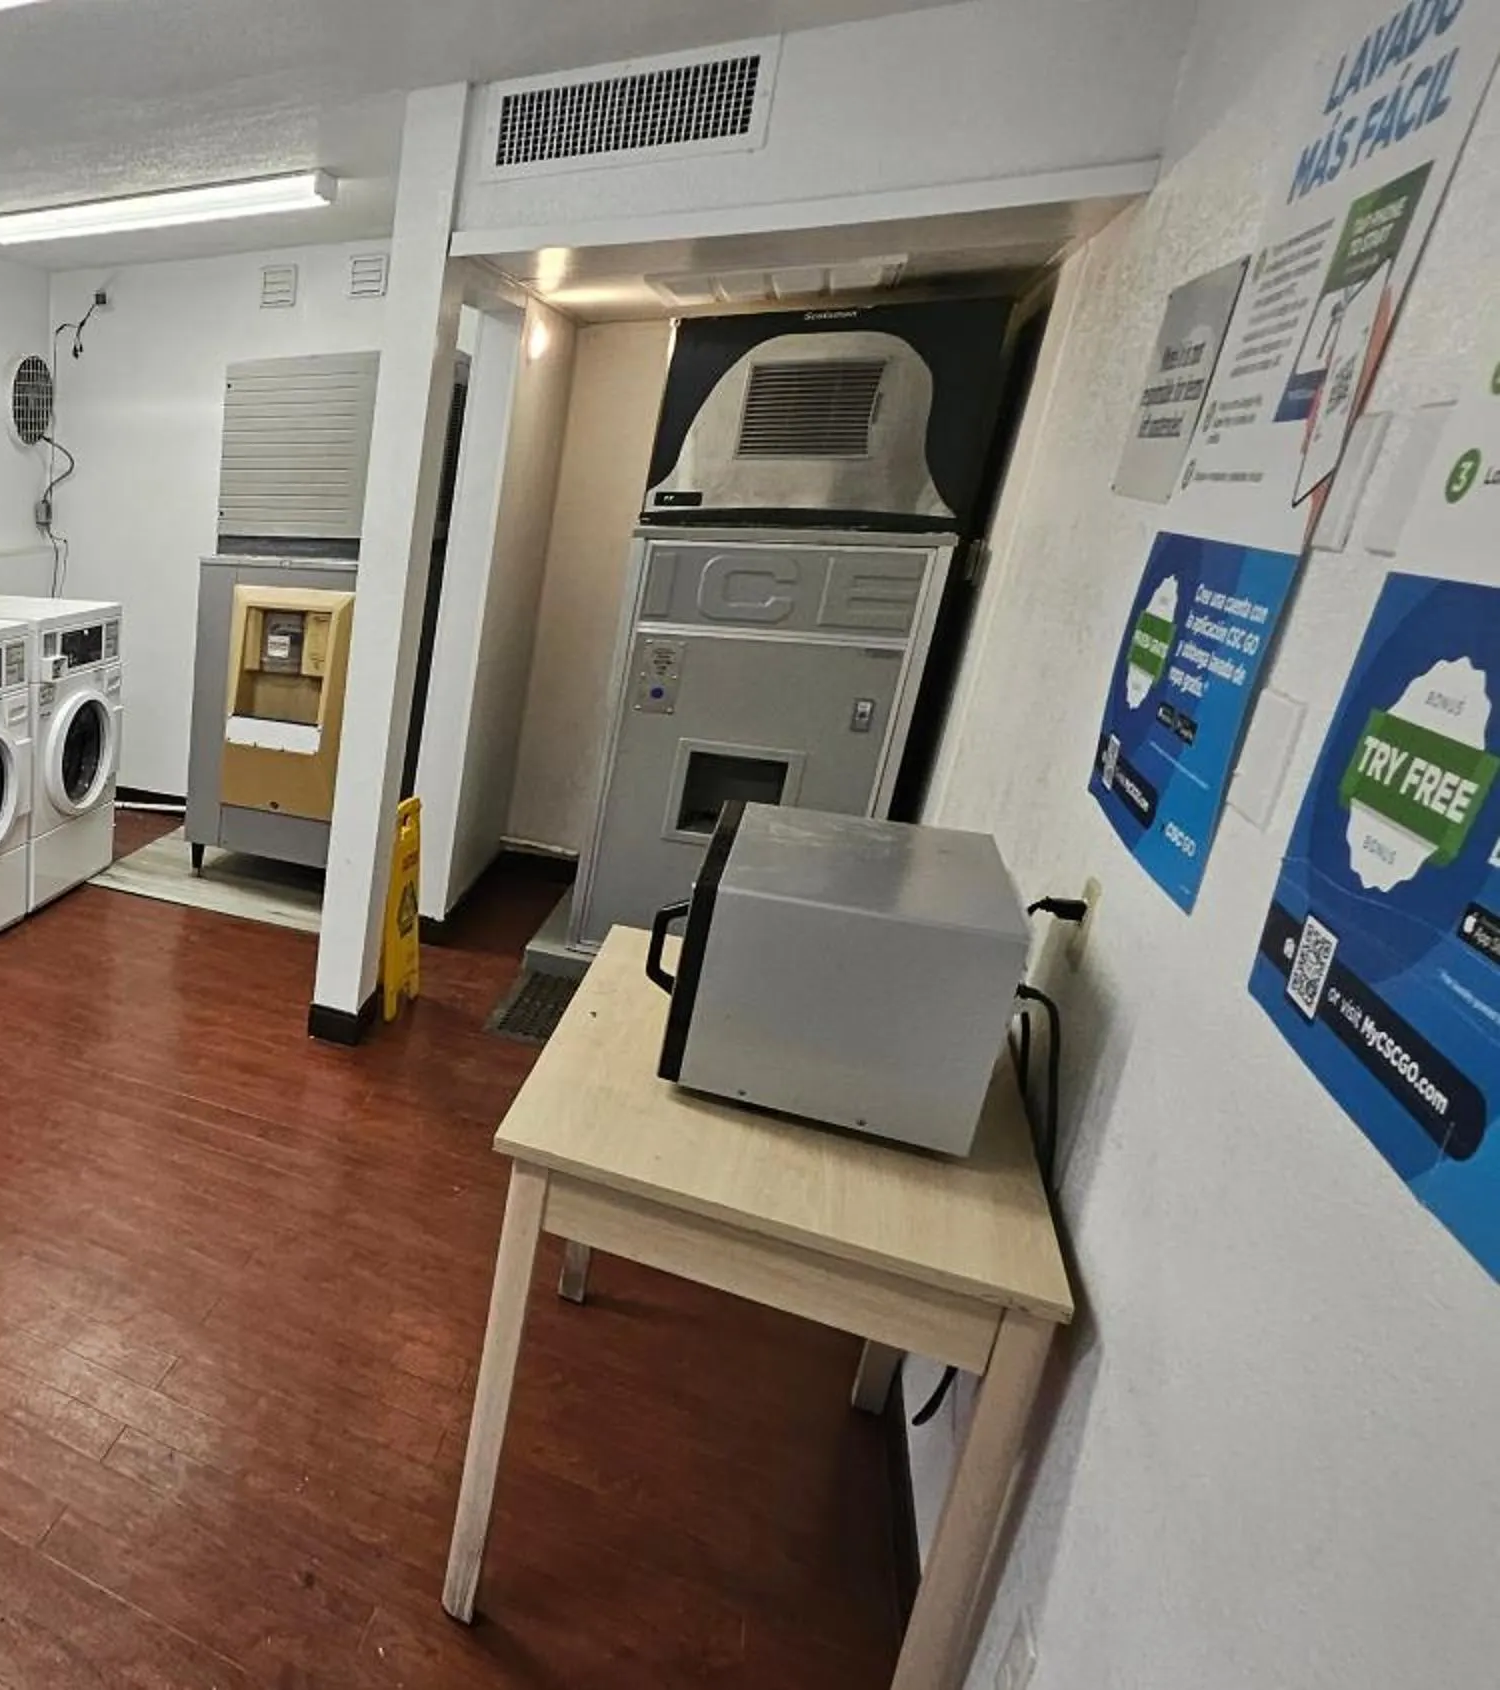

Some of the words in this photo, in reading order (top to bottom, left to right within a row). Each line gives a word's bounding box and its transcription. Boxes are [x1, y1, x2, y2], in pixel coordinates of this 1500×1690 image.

[1287, 111, 1358, 205] MÁS
[1350, 47, 1460, 169] FÁCIL
[643, 550, 928, 634] ICE
[1358, 735, 1408, 786] TRY
[1399, 756, 1480, 825] FREE
[1327, 987, 1342, 1006] or
[1339, 997, 1363, 1030] visit
[1359, 1014, 1449, 1116] MyCSCGO.com
